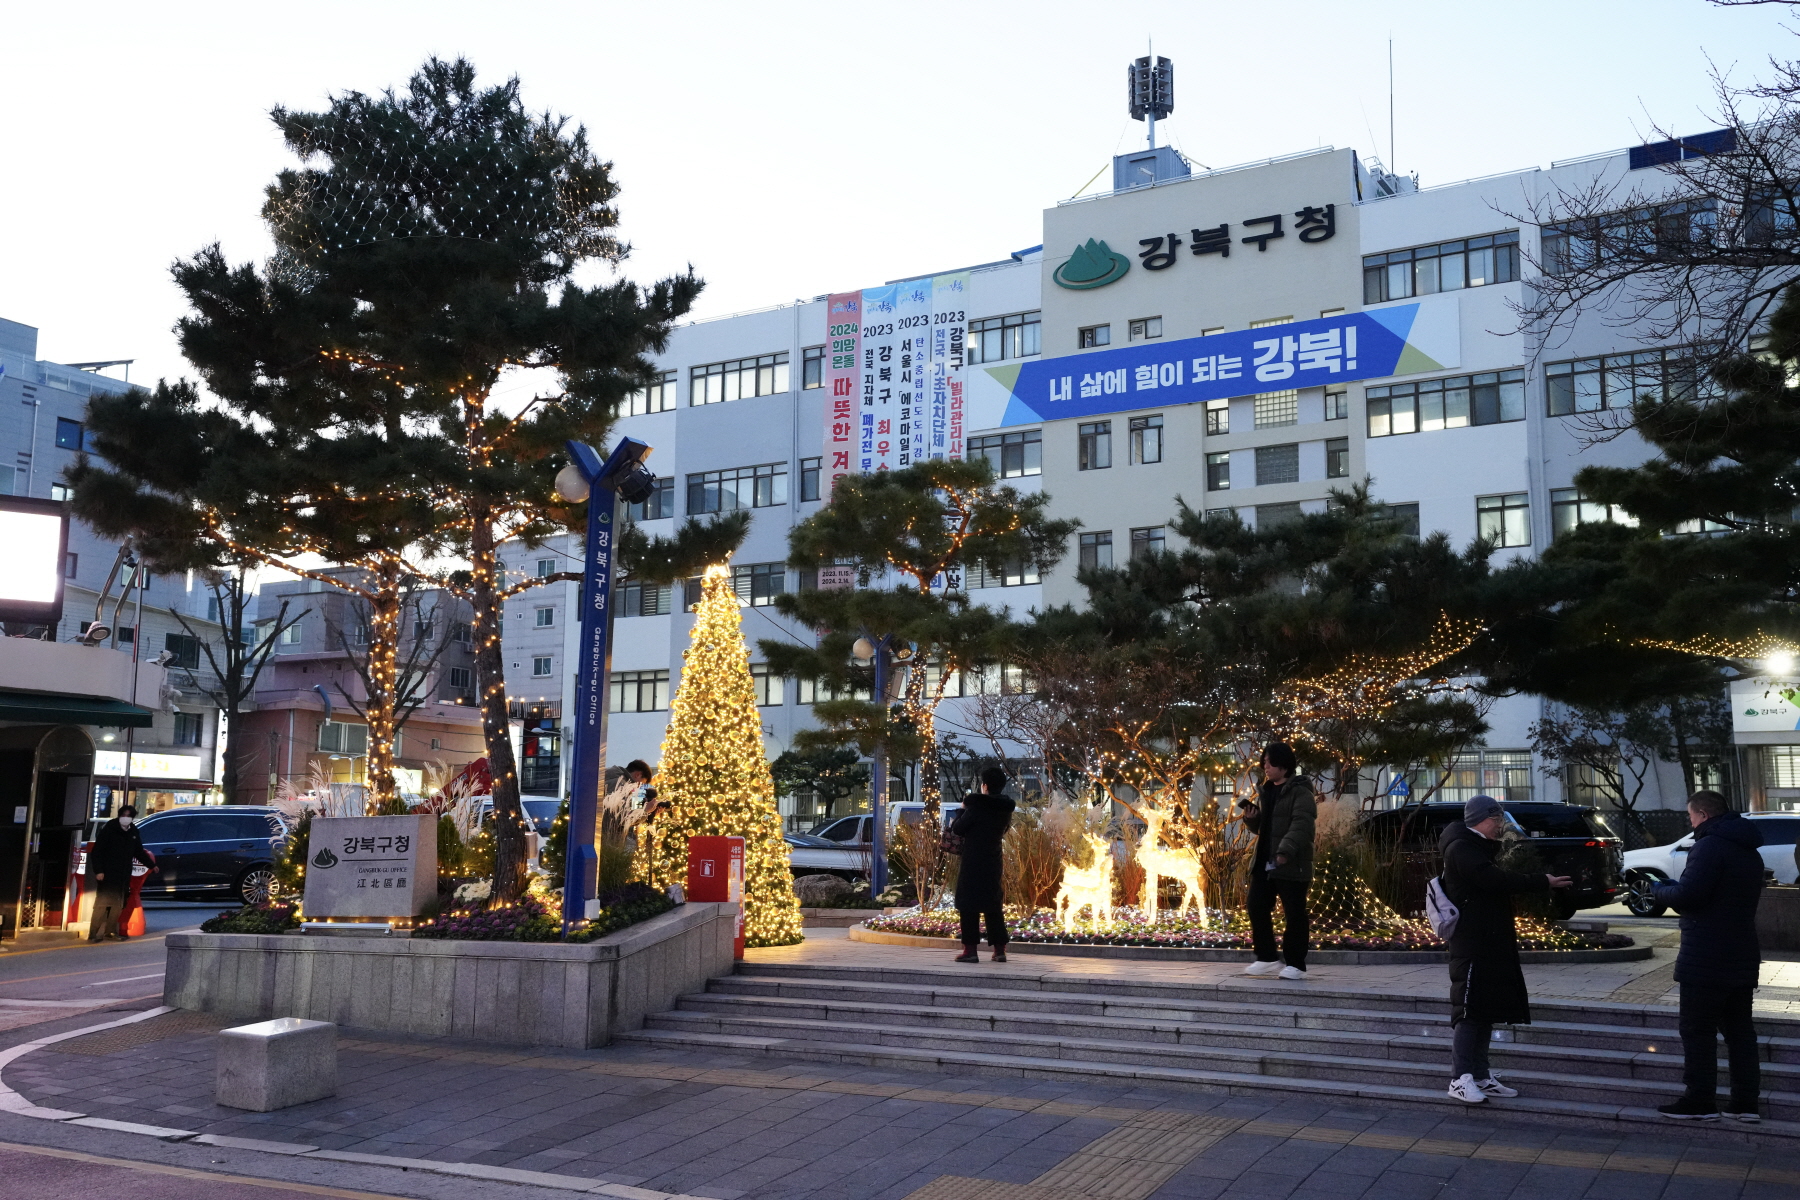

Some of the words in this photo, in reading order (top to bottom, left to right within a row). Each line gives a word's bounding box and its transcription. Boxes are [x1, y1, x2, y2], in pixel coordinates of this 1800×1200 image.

[1138, 203, 1338, 271] 강북구청
[829, 322, 859, 337] 2024
[863, 323, 893, 338] 2023
[898, 314, 929, 330] 2023
[933, 310, 965, 325] 2023
[832, 338, 856, 353] 희망
[935, 329, 946, 357] 전국
[949, 327, 965, 371] 강북구
[865, 349, 874, 370] 전국
[878, 345, 893, 404] 강북구
[900, 339, 912, 383] 서울시
[1049, 376, 1073, 402] 내
[1079, 368, 1127, 399] 삶에
[1135, 359, 1184, 391] 힘이
[1192, 354, 1243, 384] 되는
[1252, 325, 1358, 383] 강북!
[864, 374, 874, 406] 지자체
[832, 377, 852, 442] 따뜻한
[594, 531, 609, 610] 강북구청
[590, 627, 602, 692] Gangbuk-gu
[589, 694, 598, 725] Office
[343, 835, 410, 854] 강북구청
